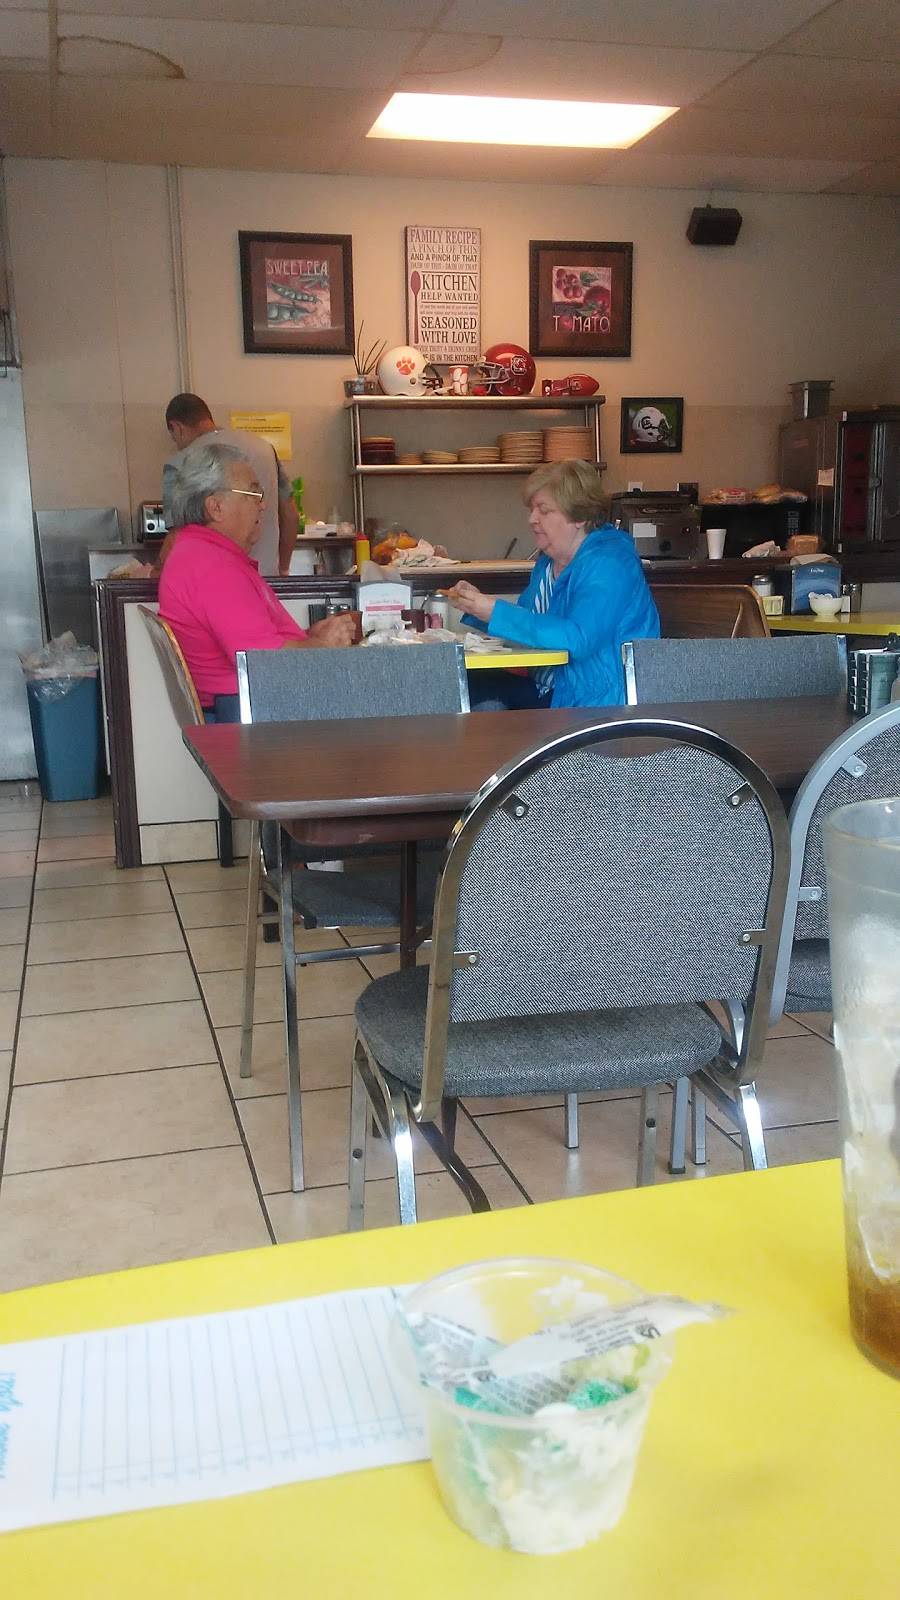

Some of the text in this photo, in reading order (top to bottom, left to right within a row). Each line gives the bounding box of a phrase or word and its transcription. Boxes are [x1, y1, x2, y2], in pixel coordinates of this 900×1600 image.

[410, 229, 477, 244] FAMILY RECIPE
[419, 244, 444, 254] PINCH
[446, 245, 456, 254] OF
[459, 245, 478, 254] THIS
[432, 254, 451, 262] PINCH
[266, 260, 328, 275] SWEET PEA
[422, 274, 477, 291] KITCHEN
[421, 292, 478, 301] HELP WANTED
[421, 316, 477, 329] SEASONED
[421, 331, 477, 344] WITH LOVE
